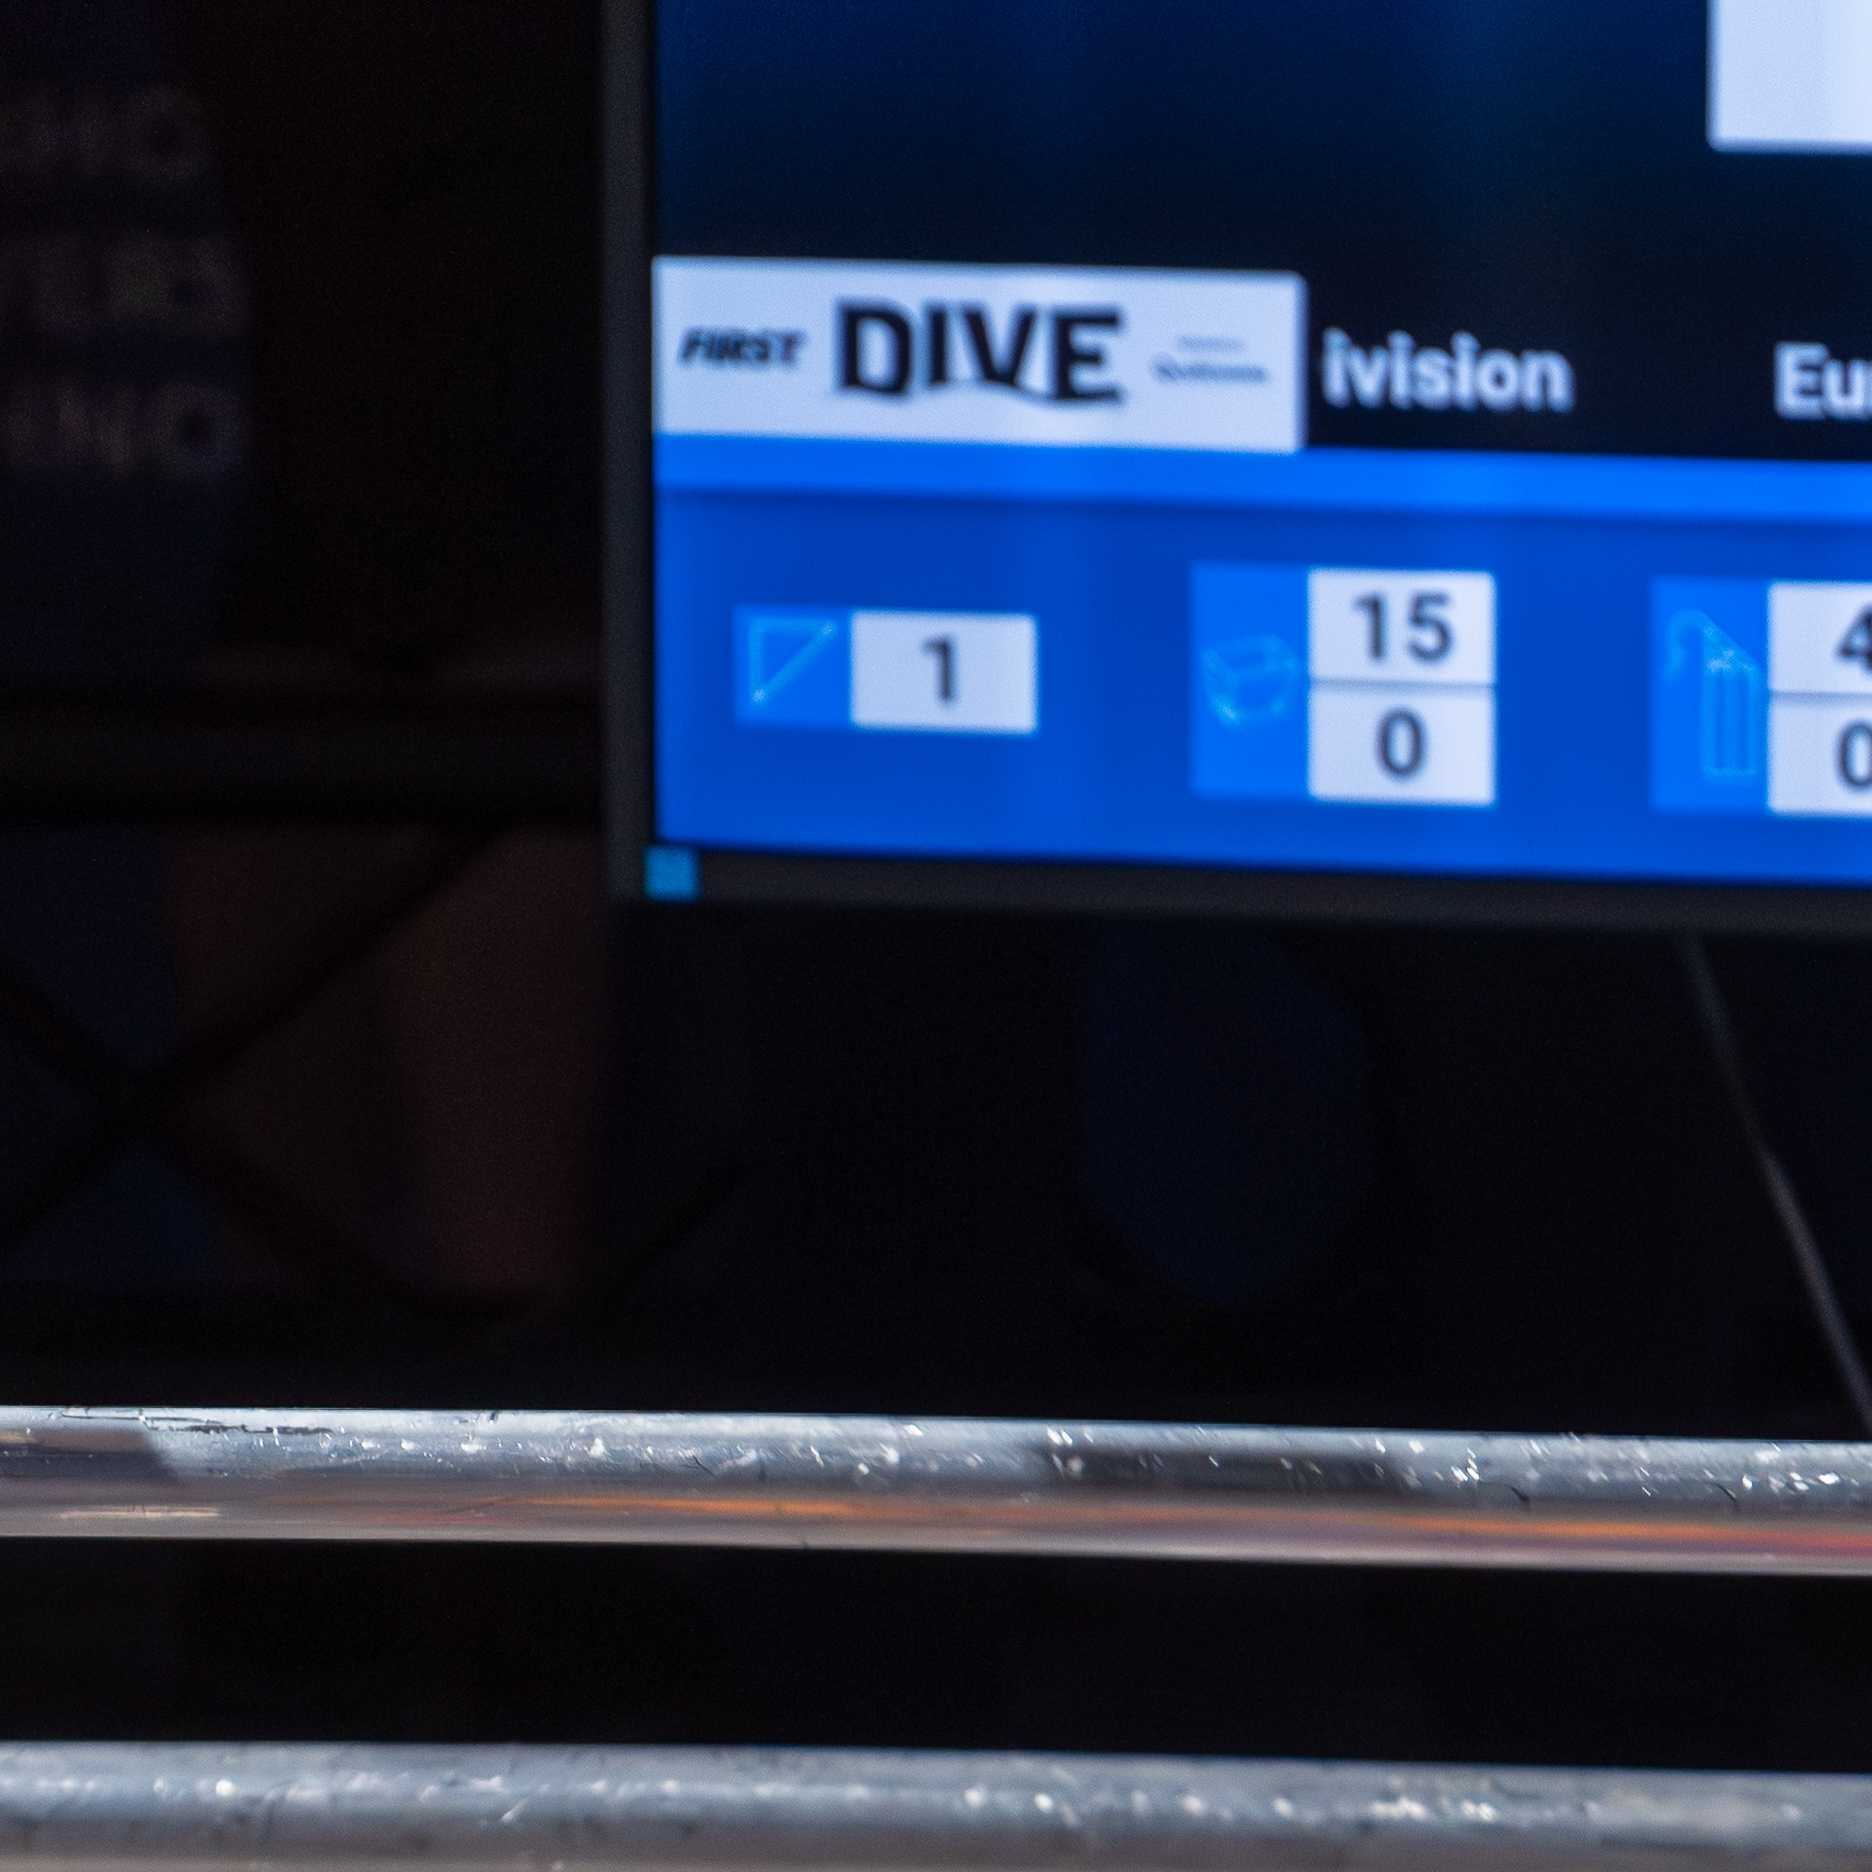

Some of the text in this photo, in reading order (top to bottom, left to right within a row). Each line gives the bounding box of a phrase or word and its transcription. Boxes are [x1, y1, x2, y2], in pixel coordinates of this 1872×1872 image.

[679, 326, 804, 368] FIRST
[834, 298, 1124, 405] DIVE
[1354, 591, 1454, 665] 15
[922, 634, 957, 705] 1
[1374, 706, 1428, 782] 0
